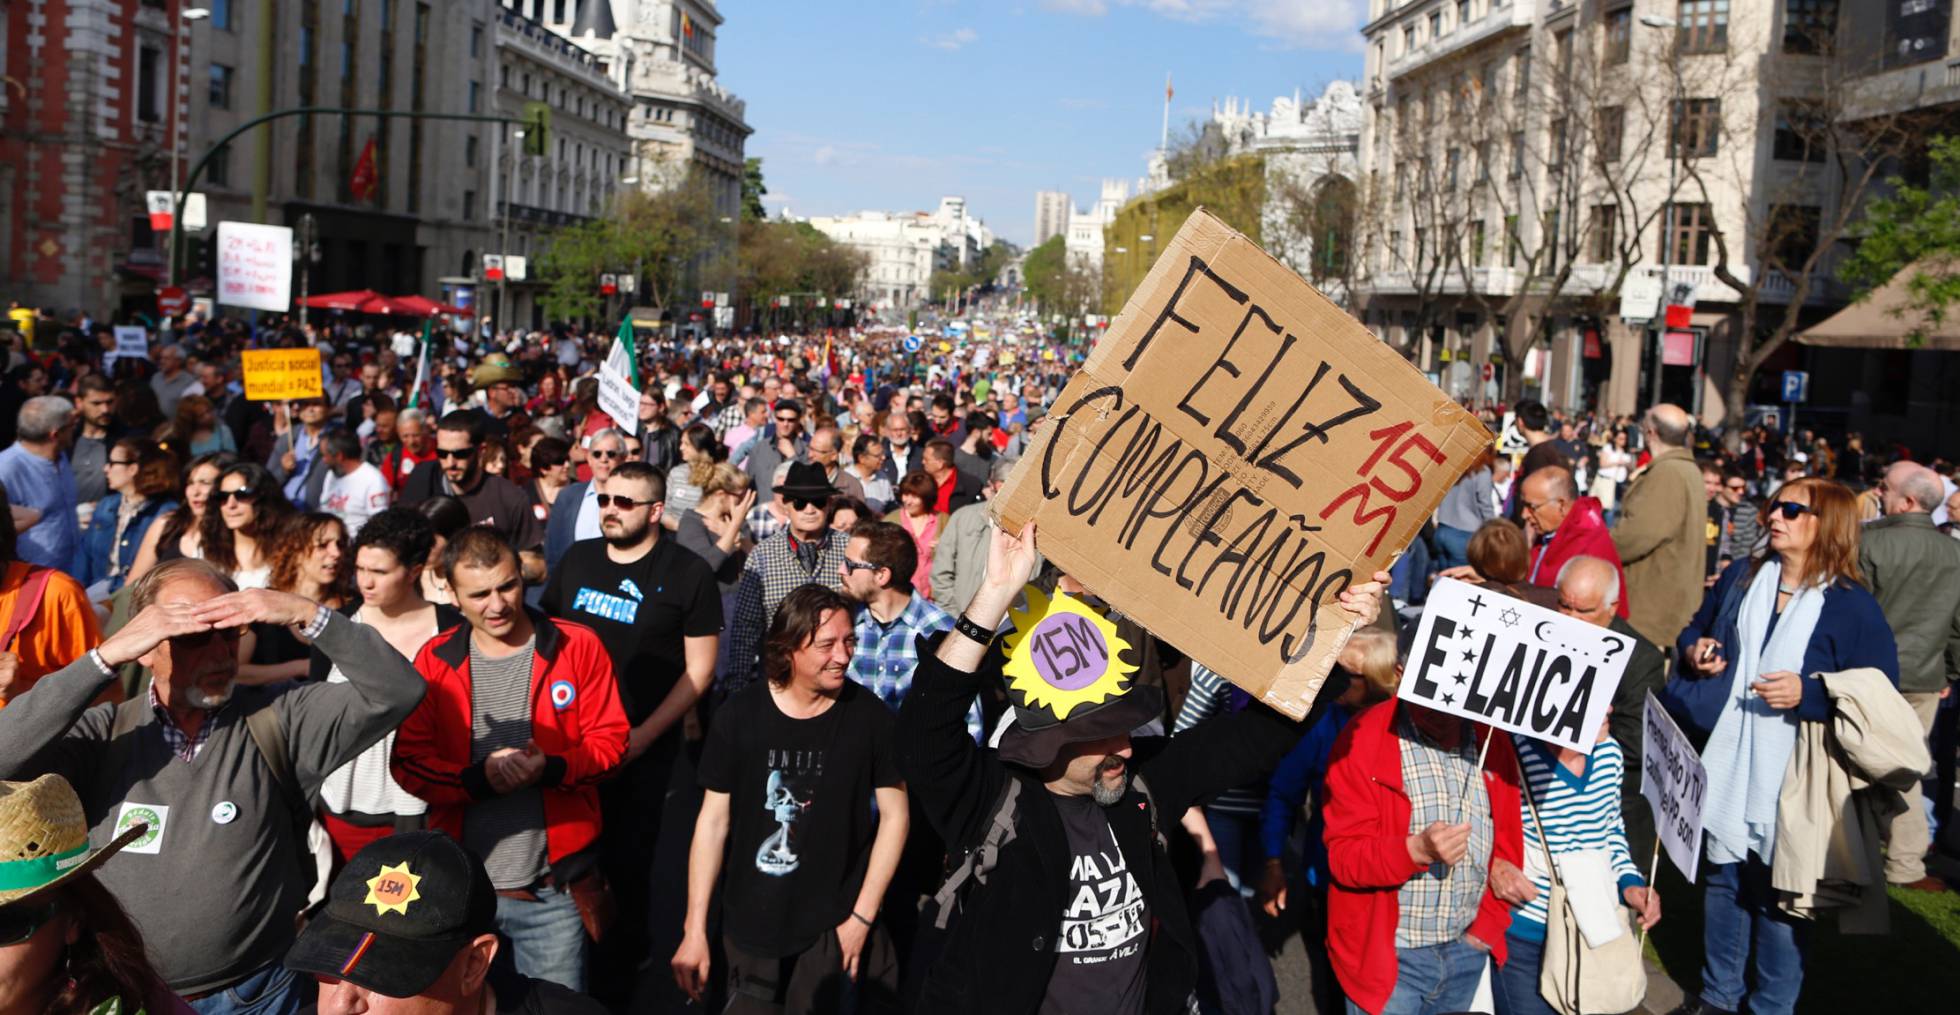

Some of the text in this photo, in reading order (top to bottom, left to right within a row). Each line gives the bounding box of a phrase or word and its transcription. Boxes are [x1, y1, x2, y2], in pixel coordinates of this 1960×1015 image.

[247, 357, 318, 372] Justicia social
[1122, 255, 1382, 489] FELIZ
[248, 381, 285, 394] mundial
[297, 377, 318, 393] PAZ
[1785, 376, 1799, 398] P
[1041, 385, 1353, 665] CUMPLEAÑOS
[1318, 483, 1402, 557] M
[1031, 617, 1108, 681] 15M
[1681, 771, 1691, 799] y
[376, 879, 404, 896] 15M
[1073, 956, 1083, 964] EL
